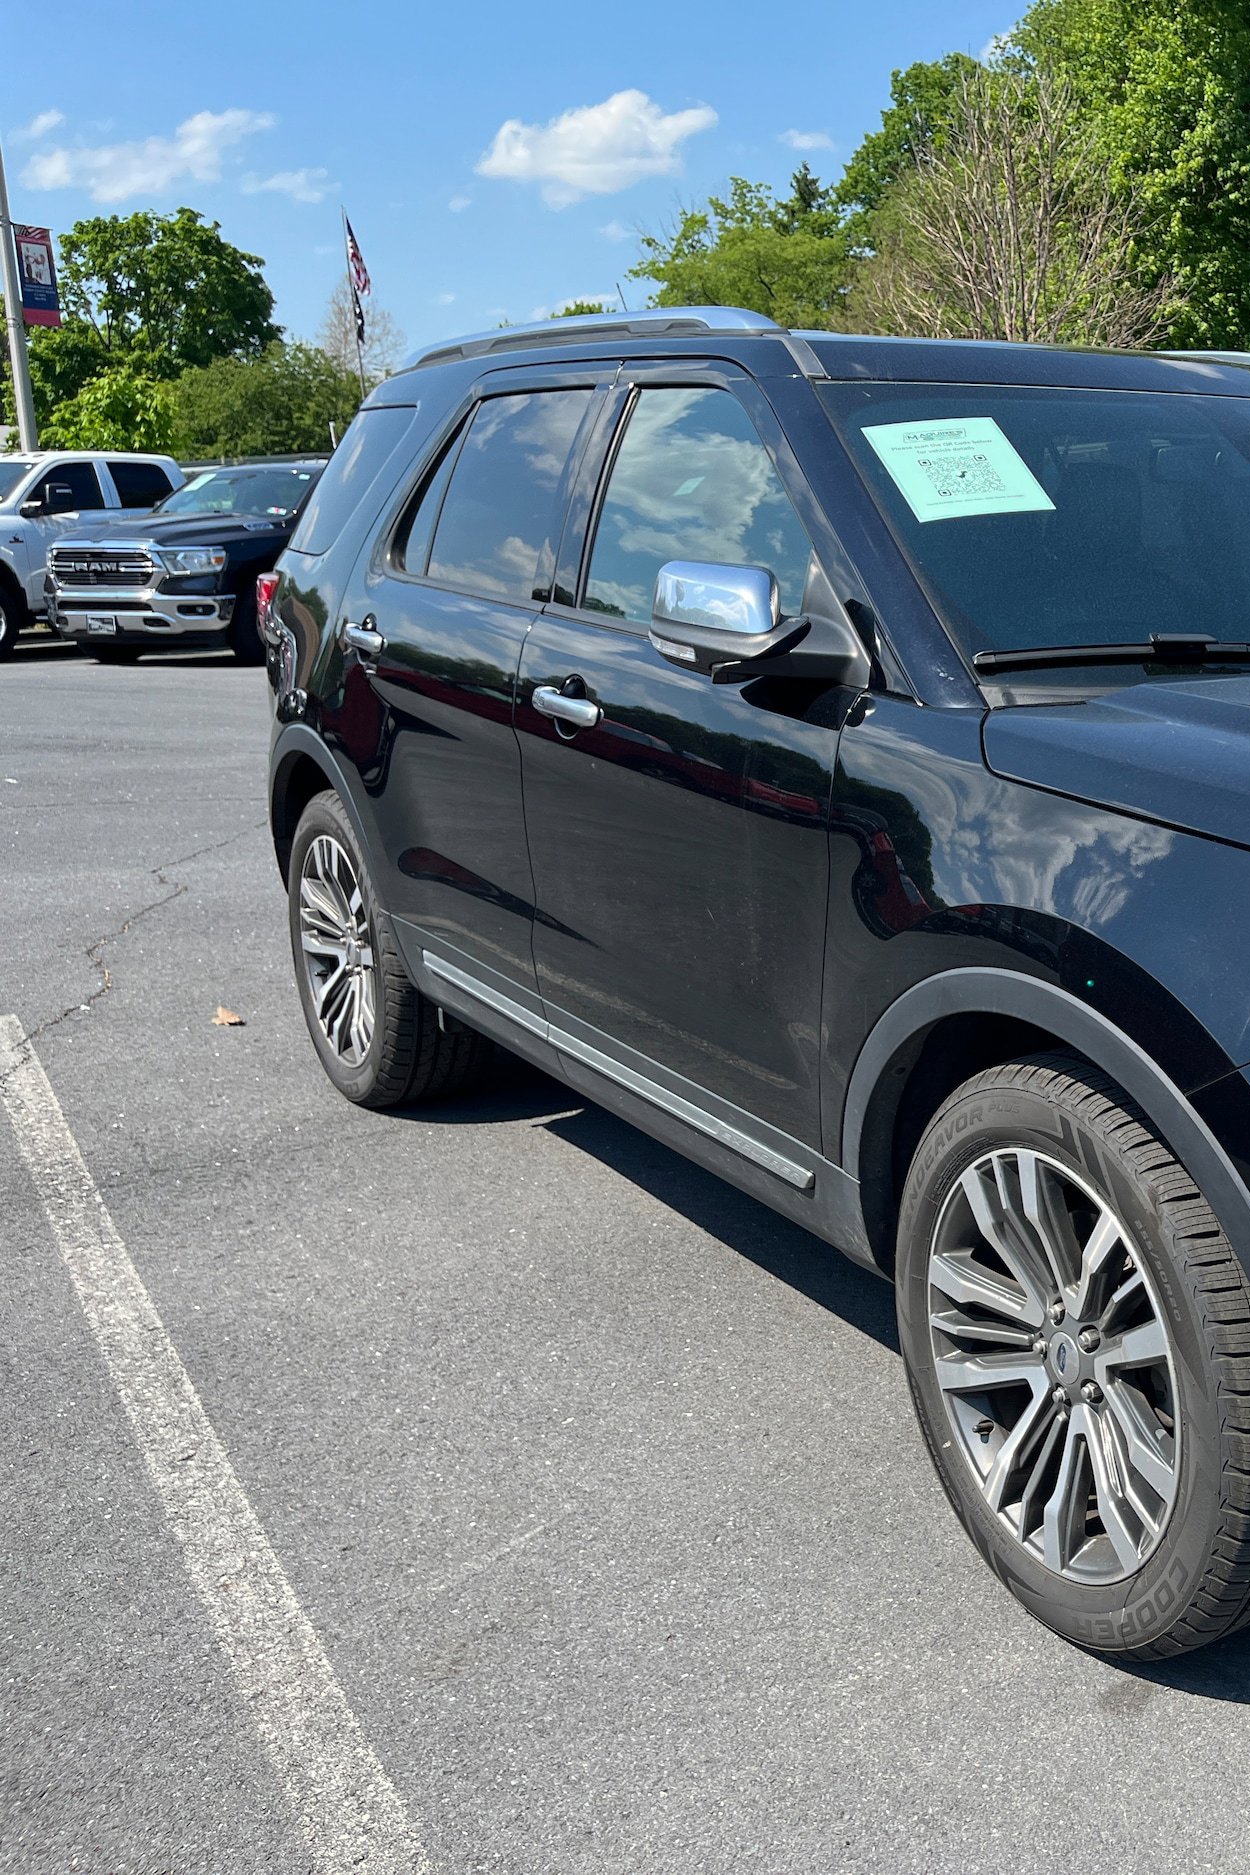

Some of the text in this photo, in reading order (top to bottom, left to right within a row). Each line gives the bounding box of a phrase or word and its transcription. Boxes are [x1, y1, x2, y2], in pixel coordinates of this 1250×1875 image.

[74, 561, 117, 572] RAM
[988, 1102, 1022, 1115] PLUS
[1071, 1556, 1189, 1641] COOPER
